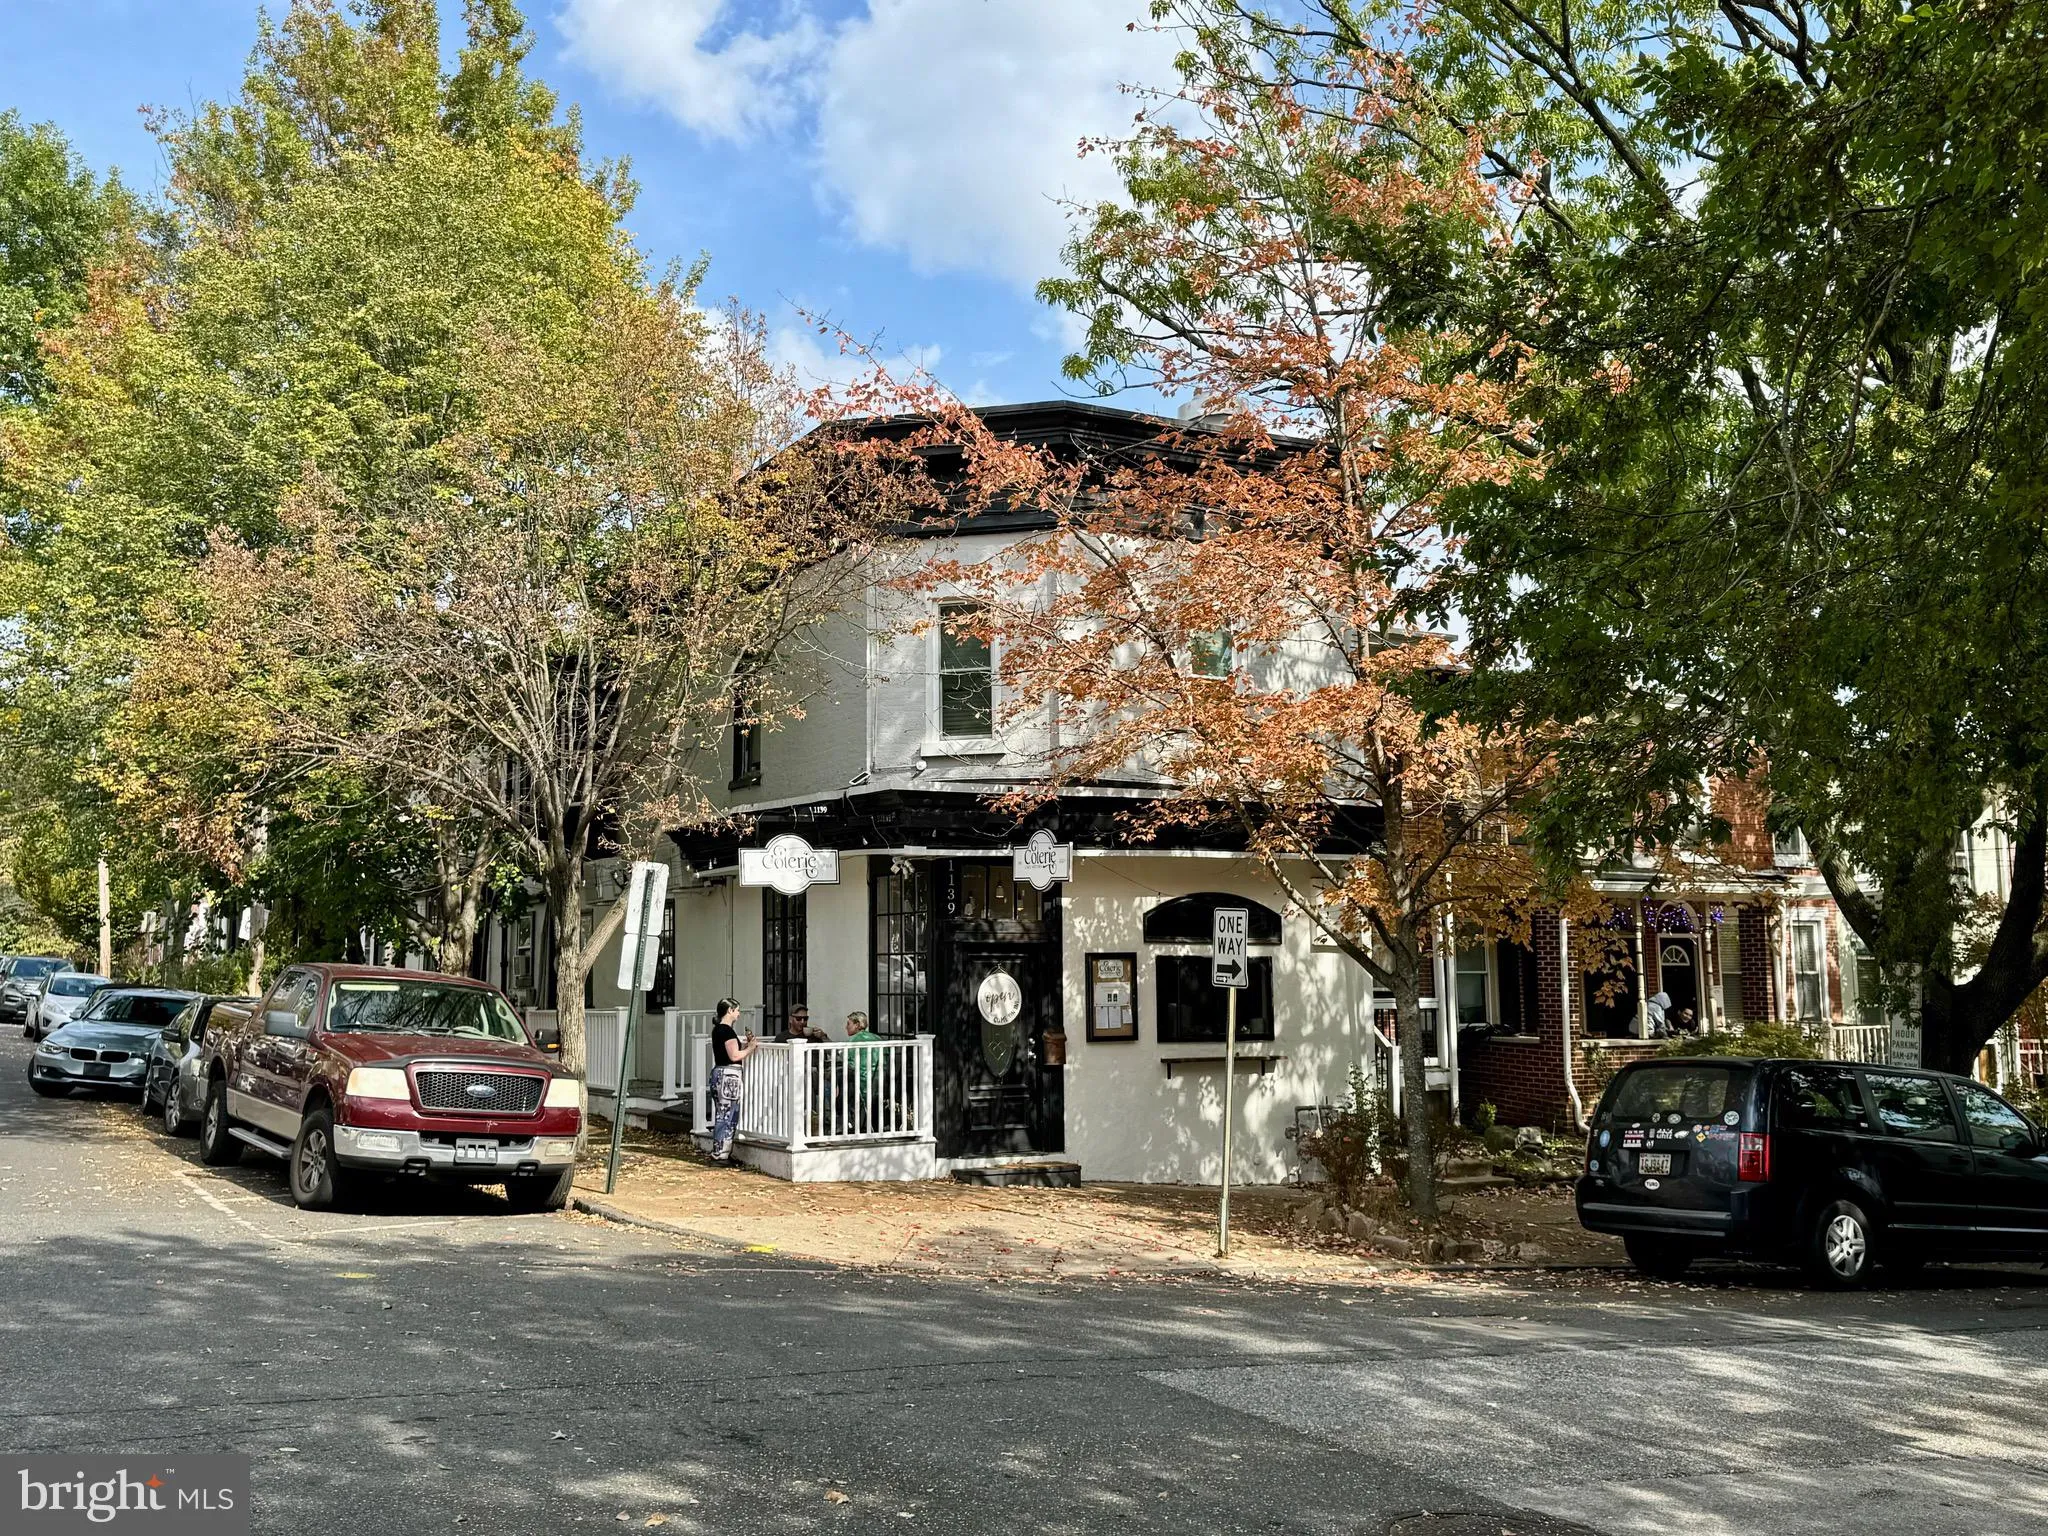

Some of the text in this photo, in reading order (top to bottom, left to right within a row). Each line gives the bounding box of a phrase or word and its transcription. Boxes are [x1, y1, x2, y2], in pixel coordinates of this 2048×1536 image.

[947, 859, 956, 914] 1139
[1218, 915, 1243, 934] ONE
[1217, 936, 1243, 955] WAY
[1895, 1029, 1915, 1039] HOUR
[1892, 1040, 1919, 1050] PARKING
